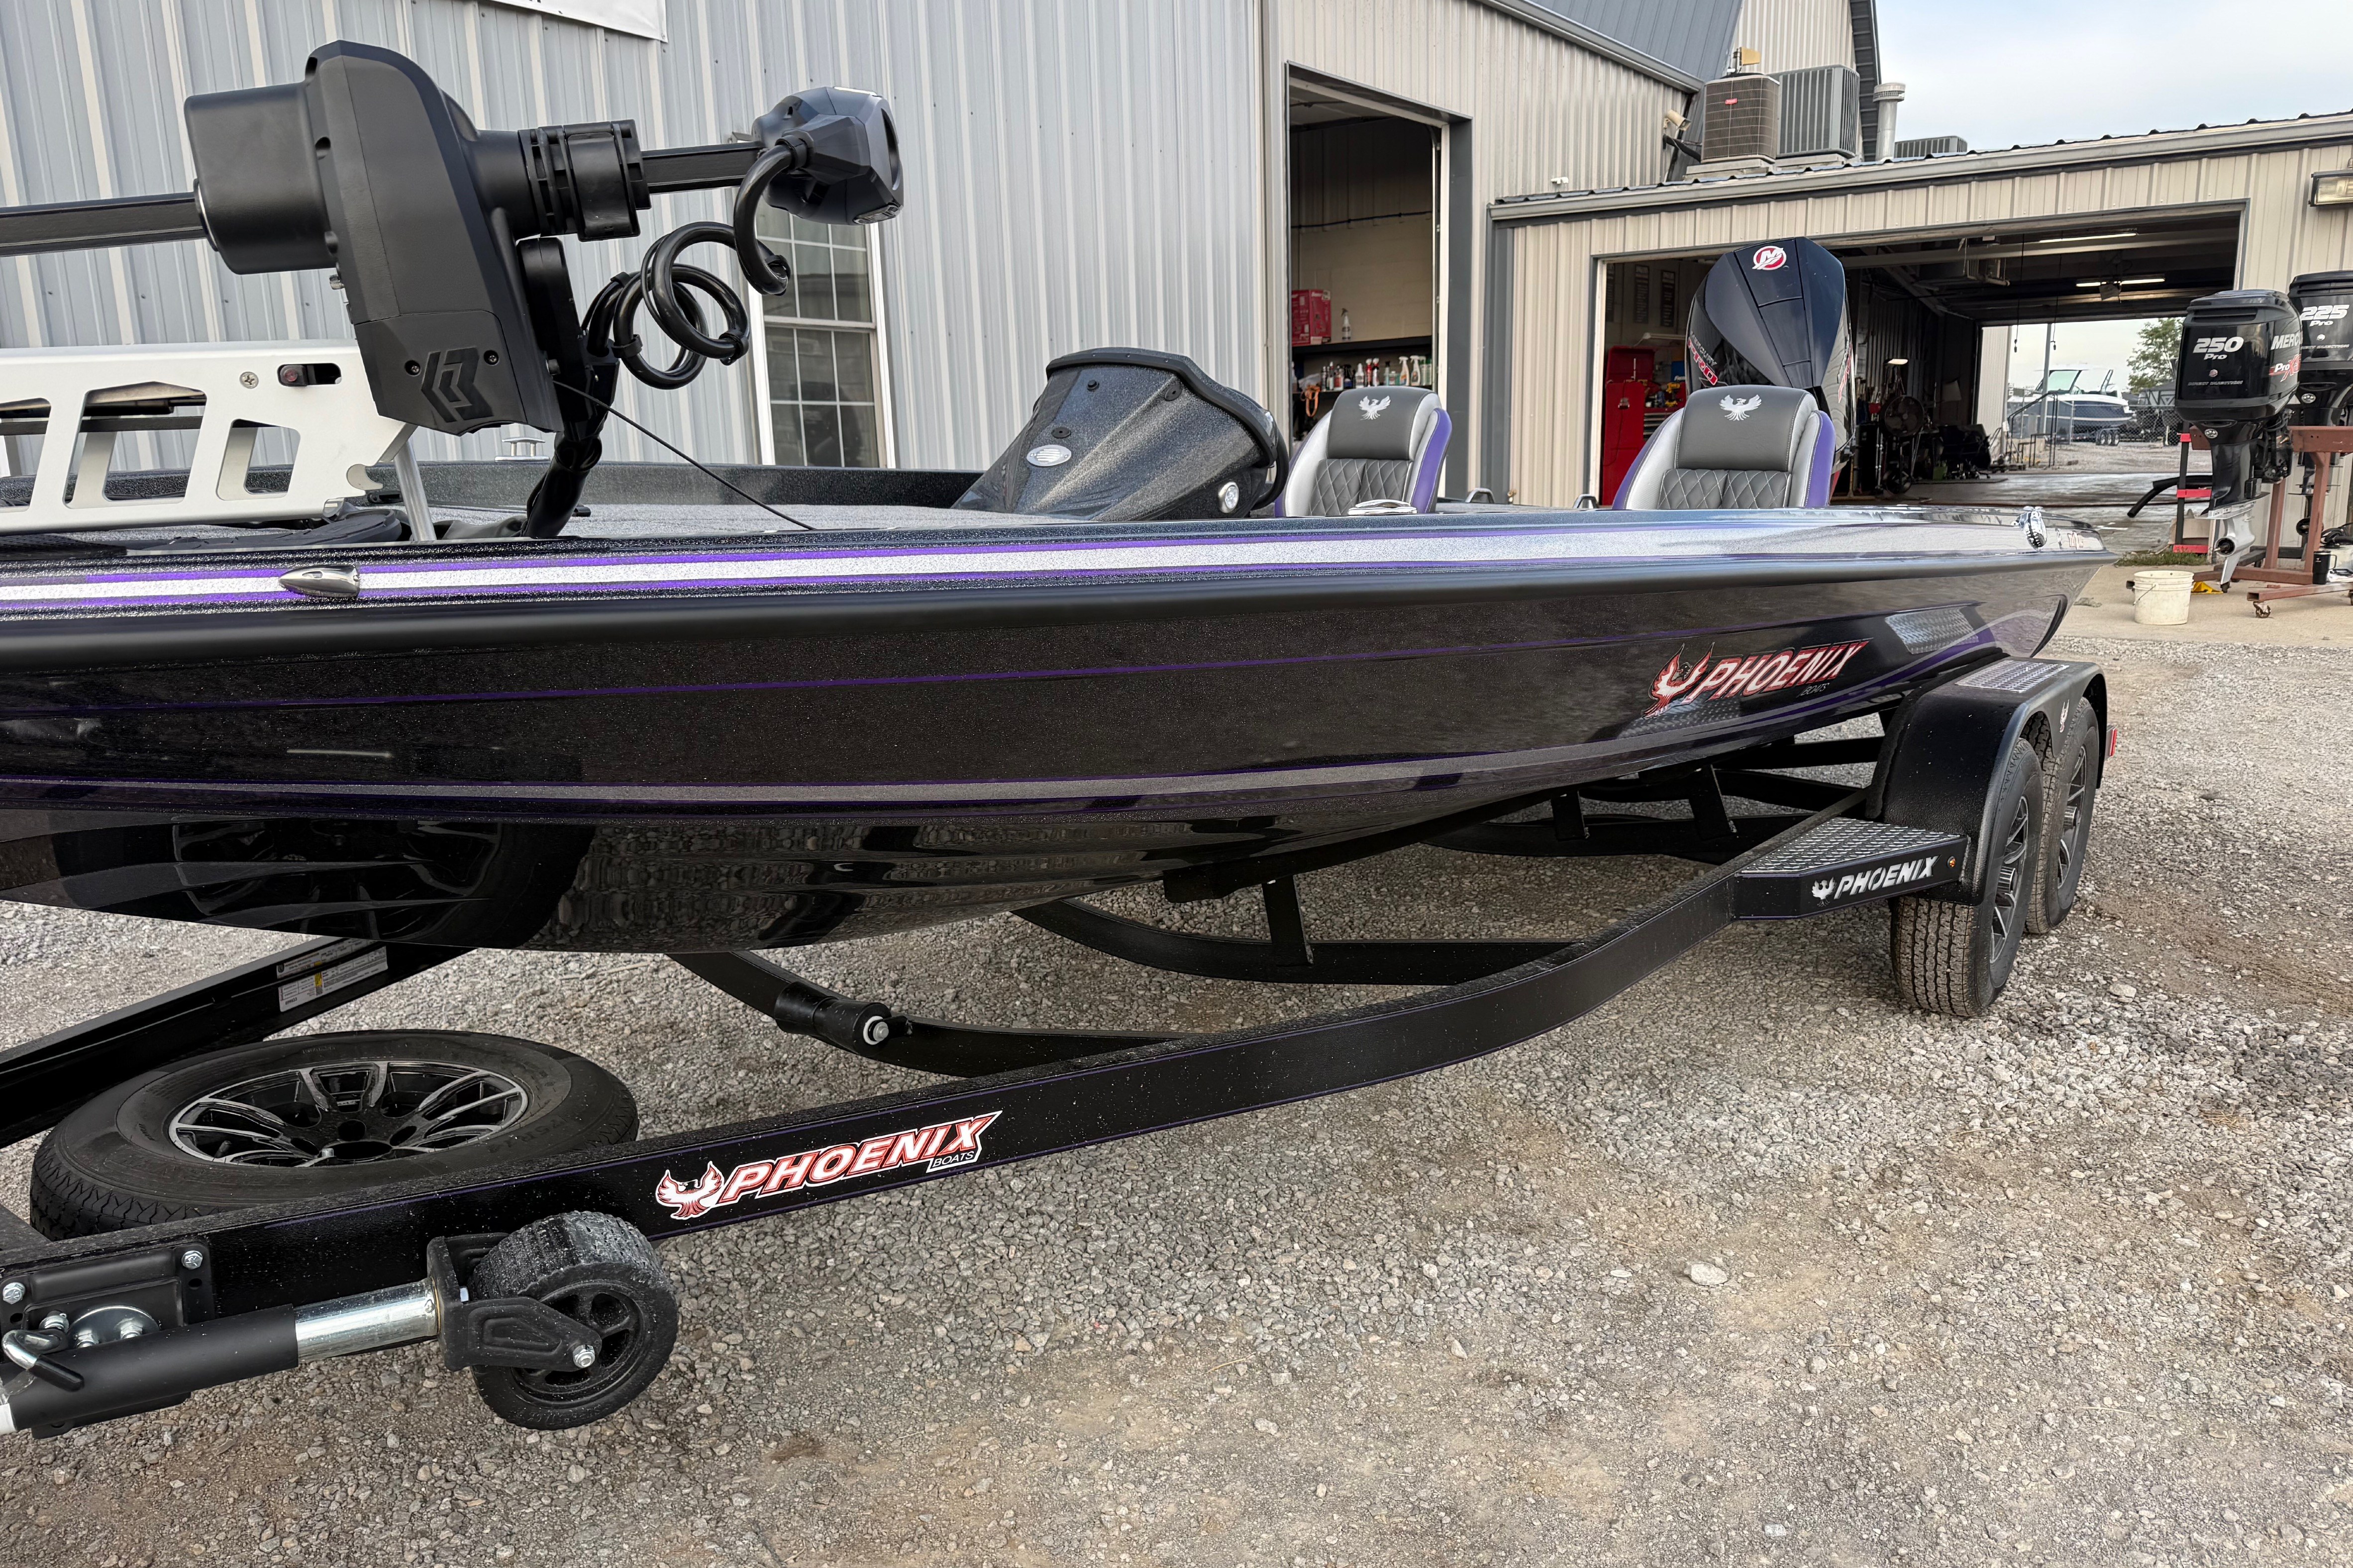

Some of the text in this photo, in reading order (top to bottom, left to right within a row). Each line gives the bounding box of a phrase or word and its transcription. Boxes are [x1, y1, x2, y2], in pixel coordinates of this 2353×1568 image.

[2299, 304, 2350, 321] 225
[2193, 336, 2244, 353] 250
[1684, 640, 1870, 702] PHOENIX
[1800, 682, 1830, 696] BOATS
[1834, 855, 1940, 900] PHOENIX
[718, 1114, 997, 1204] PHOENIX
[932, 1150, 975, 1169] BOATS
